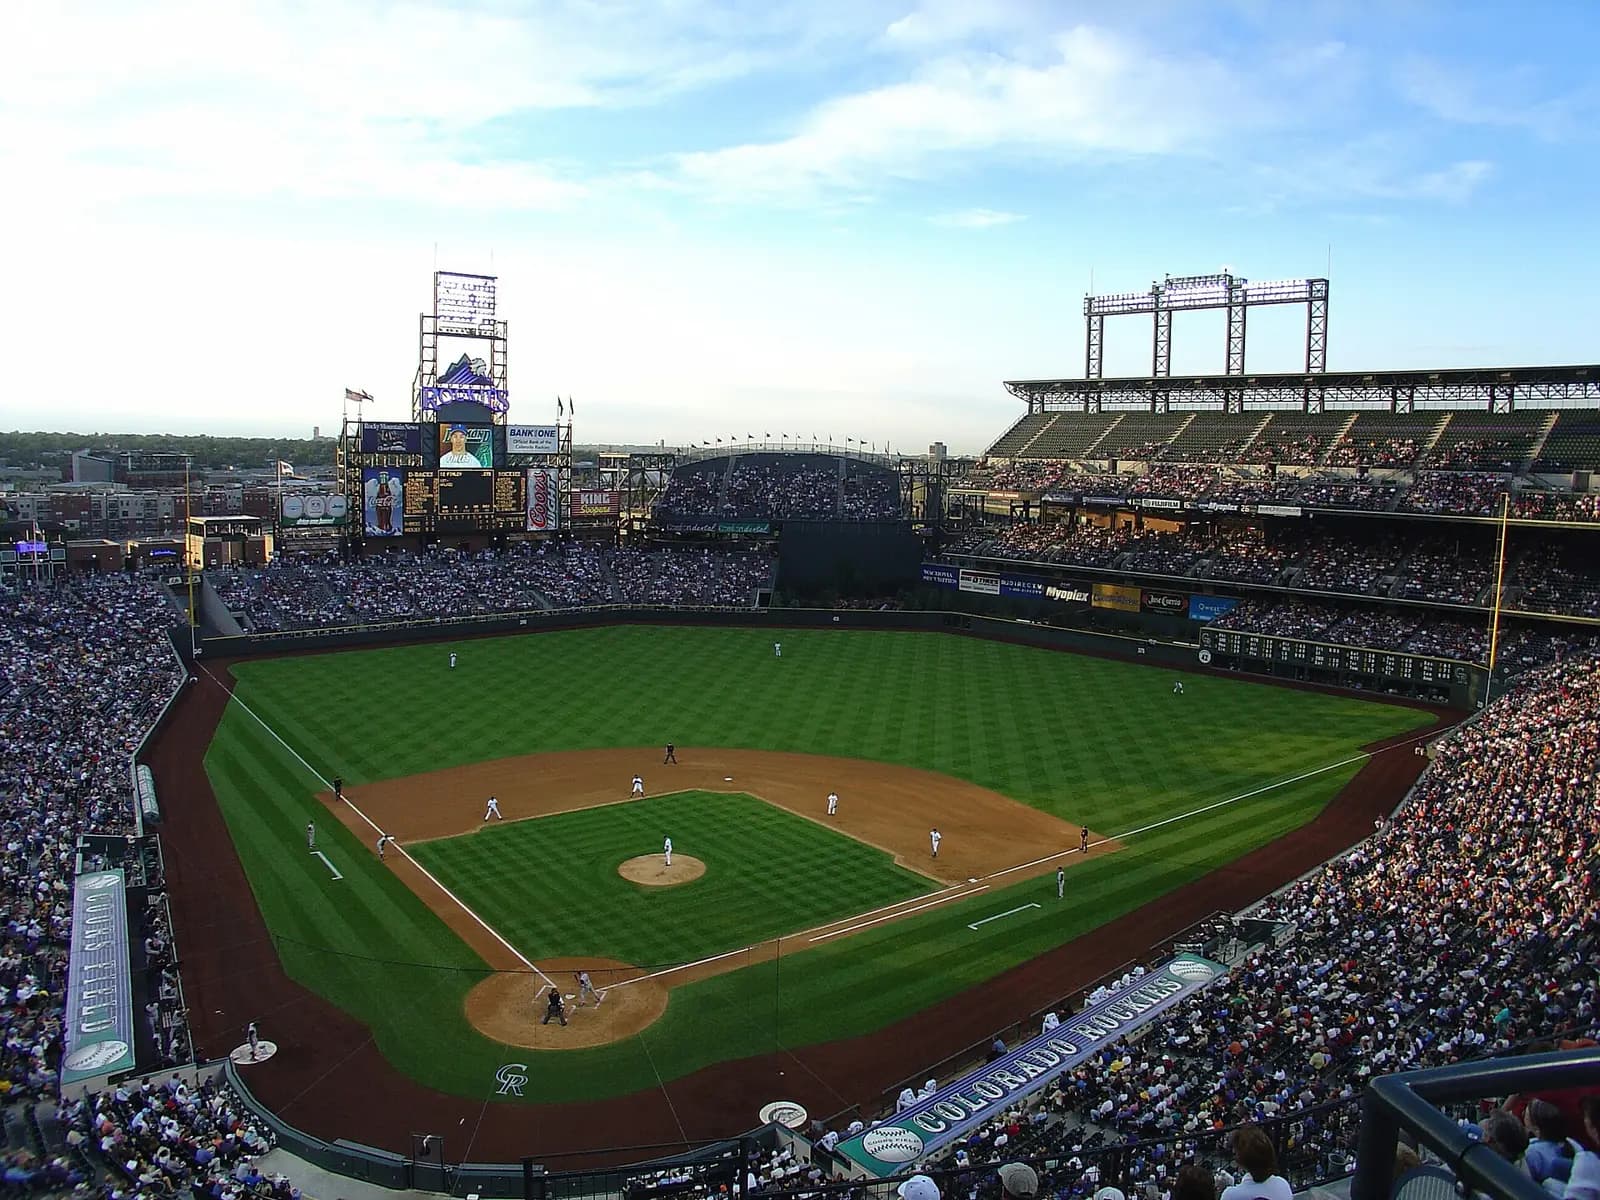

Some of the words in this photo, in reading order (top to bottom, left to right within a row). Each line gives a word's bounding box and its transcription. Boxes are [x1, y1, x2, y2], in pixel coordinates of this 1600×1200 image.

[422, 387, 510, 413] ROCKIES
[510, 429, 534, 437] BANK
[538, 430, 556, 438] ONE
[530, 470, 547, 528] Coors
[547, 474, 557, 528] LIGHT
[580, 494, 610, 504] KING
[1208, 502, 1238, 512] Myoplex
[1046, 587, 1089, 602] Myoplex
[85, 892, 114, 951] COORS
[81, 959, 117, 1032] FIELD
[1071, 976, 1183, 1041] ROCKIES
[913, 1037, 1079, 1133] COLORADO
